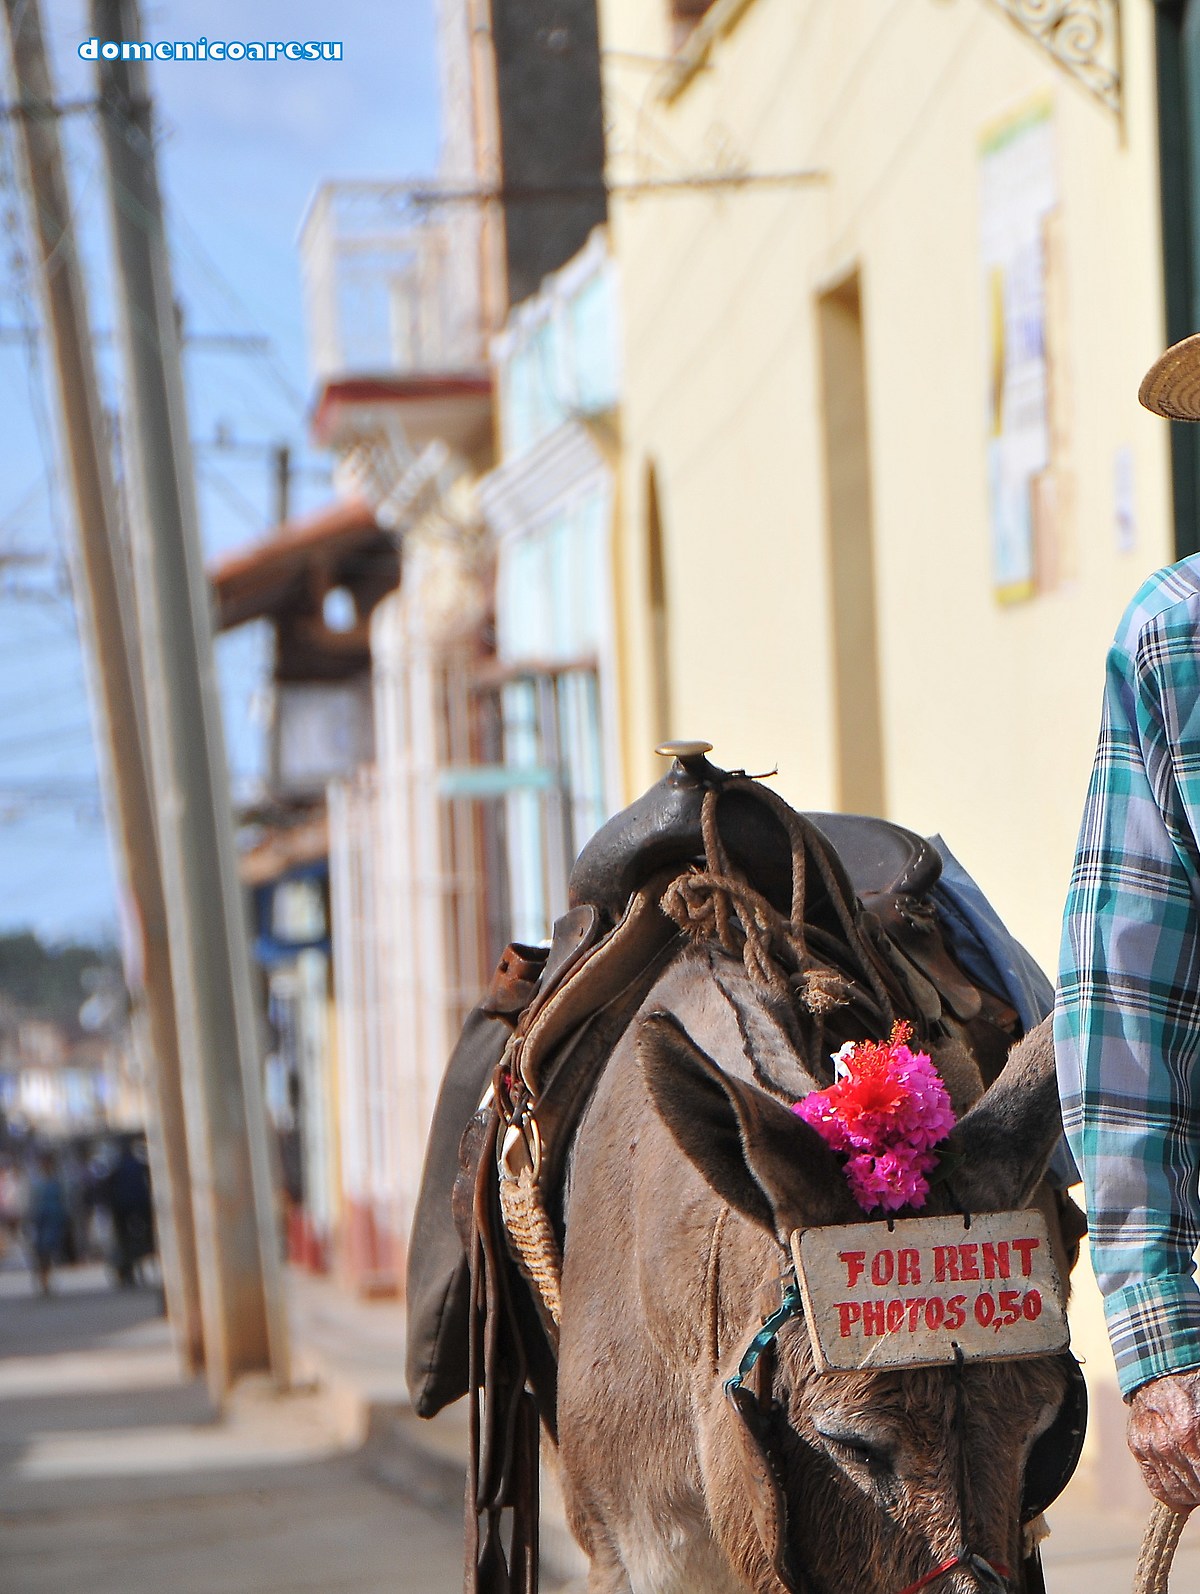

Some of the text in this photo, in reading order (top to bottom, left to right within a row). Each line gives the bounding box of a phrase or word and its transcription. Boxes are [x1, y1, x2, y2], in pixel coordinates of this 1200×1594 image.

[838, 1238, 1041, 1288] FOR RENT
[833, 1289, 1043, 1338] PHOTOS 0,50
